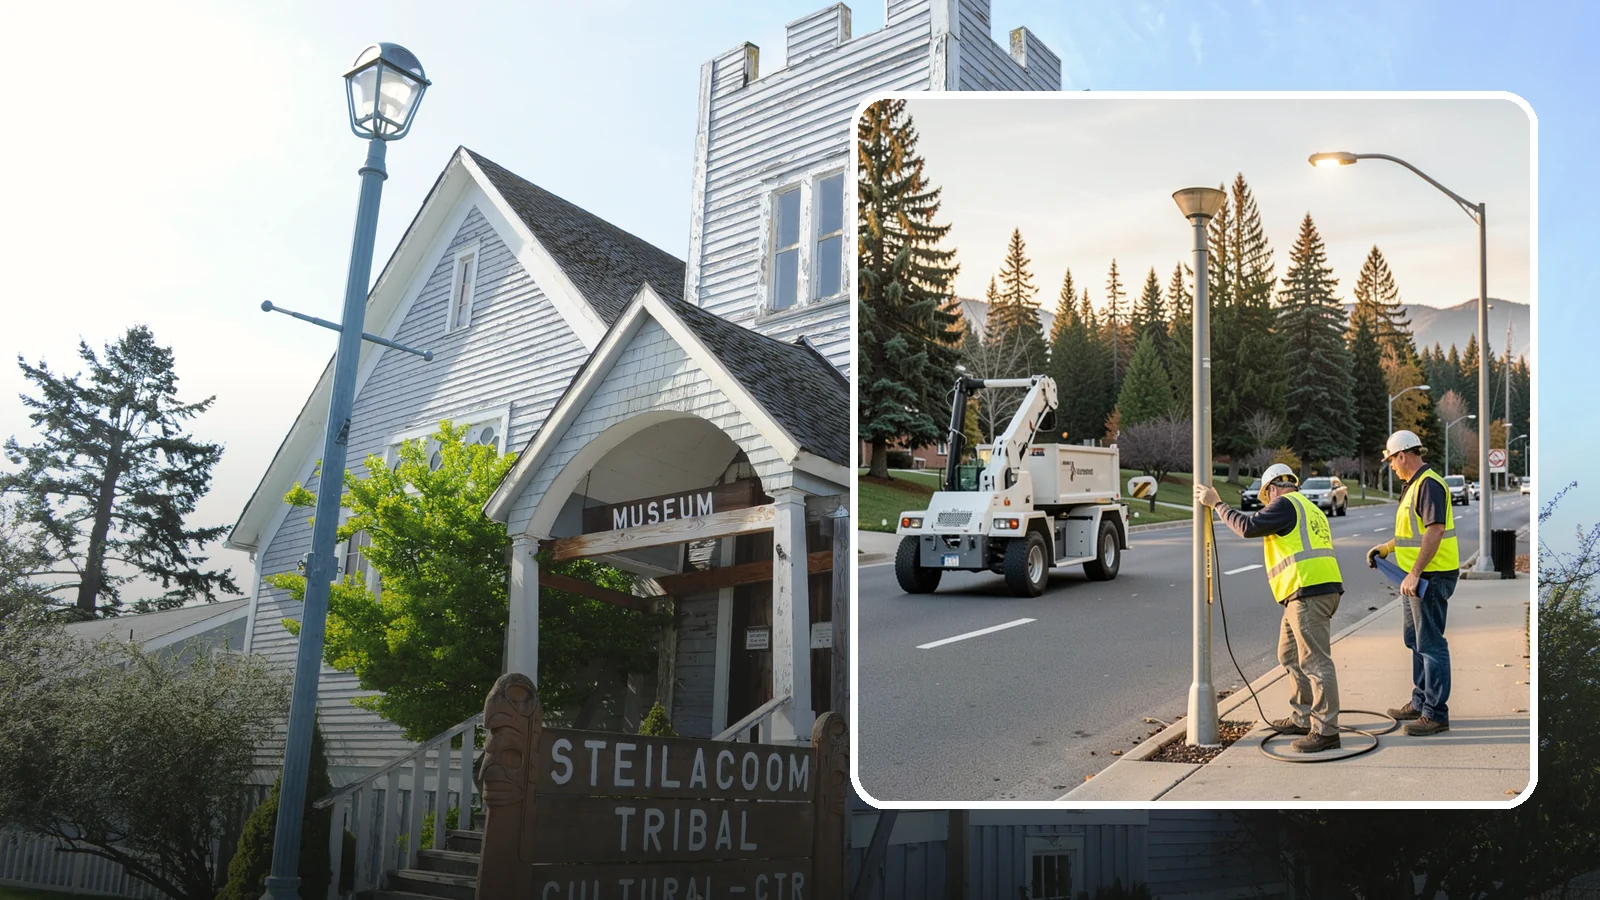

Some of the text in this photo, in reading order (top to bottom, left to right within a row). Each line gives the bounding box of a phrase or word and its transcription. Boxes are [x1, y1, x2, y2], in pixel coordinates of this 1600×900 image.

[612, 491, 714, 531] MUSEUM
[550, 738, 810, 793] STEILACOOM
[615, 806, 758, 851] TRIBAL
